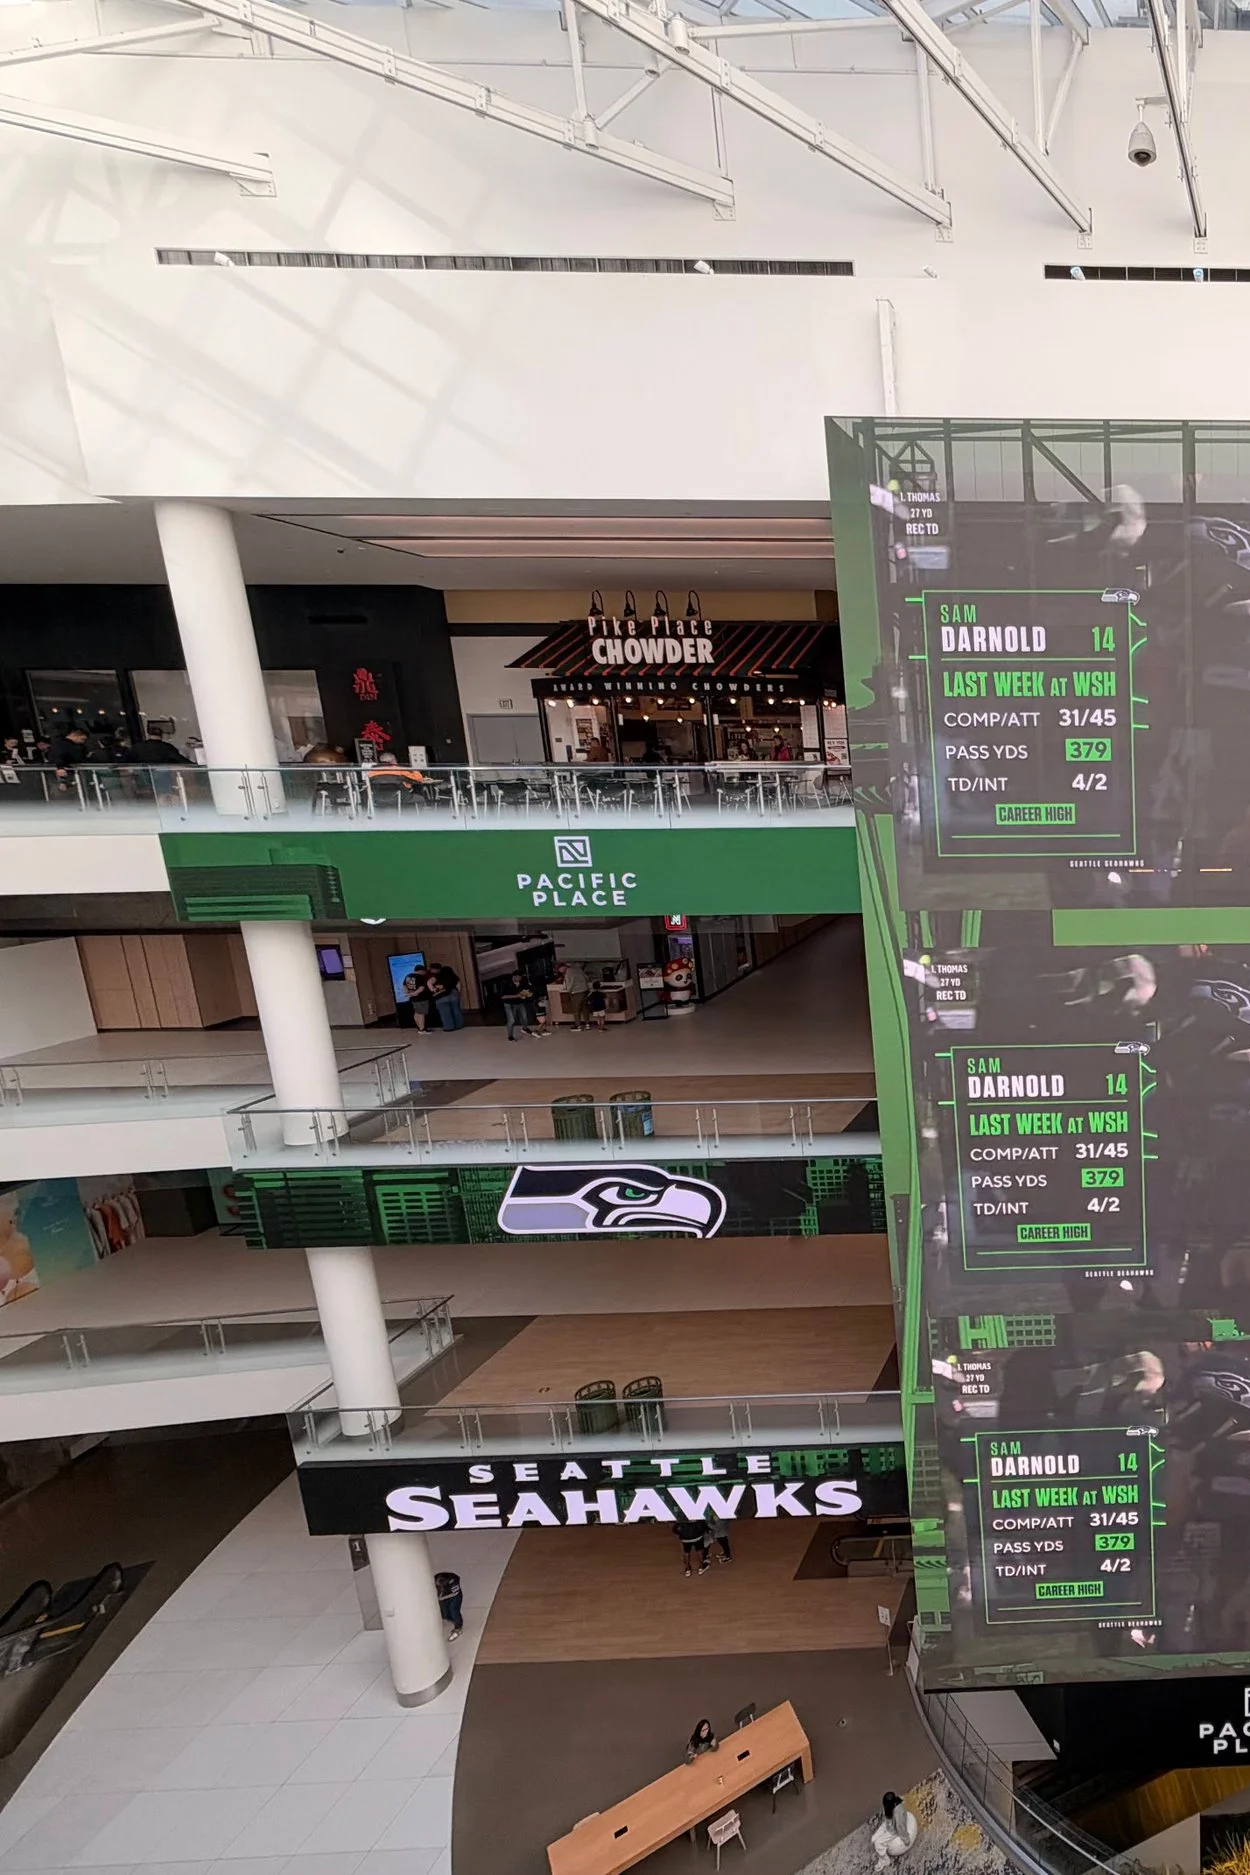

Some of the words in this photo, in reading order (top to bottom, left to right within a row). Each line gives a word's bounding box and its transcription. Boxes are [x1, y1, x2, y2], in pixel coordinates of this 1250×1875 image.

[907, 492, 940, 502] THOMAS
[910, 508, 920, 518] 27
[922, 508, 932, 518] YD
[906, 523, 925, 535] REC
[926, 523, 939, 534] TD
[940, 604, 977, 624] SAM
[588, 616, 636, 636] Pike
[651, 616, 712, 636] Place
[941, 626, 1046, 653] DARNOLD
[1091, 626, 1116, 652] 14
[592, 638, 715, 664] CHOWDER
[553, 682, 593, 692] AWARD
[604, 682, 677, 691] WINNING
[692, 682, 784, 693] CHOWDERS
[943, 672, 988, 698] LAST
[994, 671, 1045, 698] WEEK
[1050, 677, 1068, 696] AT
[1072, 671, 1117, 698] WSH
[944, 712, 1040, 728] COMP/ATT
[1058, 709, 1117, 728] 31/45
[945, 745, 990, 760] PASS
[993, 744, 1029, 760] YDS
[1070, 742, 1107, 760] 379
[948, 776, 1009, 792] TD/INT
[1072, 774, 1108, 792] 4/2
[999, 806, 1043, 823] CAREER
[1045, 805, 1074, 823] HIGH
[1070, 860, 1101, 868] SEATTLE
[518, 872, 638, 889] PACIFIC
[534, 890, 626, 907] PLACE
[938, 964, 968, 974] THOMAS
[940, 978, 949, 987] 27
[951, 978, 961, 987] YD
[936, 990, 953, 1001] REC
[954, 990, 966, 1000] TD
[968, 1058, 1001, 1074] SAM
[968, 1075, 1065, 1098] DARNOLD
[1106, 1073, 1128, 1095] 14
[970, 1113, 1011, 1136] LAST
[1016, 1113, 1062, 1135] WEEK
[1067, 1116, 1084, 1134] AT
[1088, 1111, 1128, 1133] WSH
[970, 1146, 1058, 1162] COMP/ATT
[1075, 1143, 1128, 1159] 31/45
[972, 1175, 1012, 1188] PASS
[1015, 1174, 1047, 1188] YDS
[1086, 1170, 1119, 1185] 379
[974, 1201, 1029, 1216] TD/INT
[1087, 1197, 1120, 1213] 4/2
[1020, 1225, 1060, 1241] CAREER
[1062, 1225, 1088, 1240] HIGH
[1085, 1270, 1114, 1278] SEATTLE
[963, 1362, 992, 1371] THOMAS
[965, 1374, 975, 1382] 27
[976, 1374, 985, 1382] YD
[962, 1384, 978, 1394] REC
[979, 1384, 990, 1394] TD
[990, 1442, 1021, 1455] SAM
[468, 1455, 773, 1484] SEATTLE
[991, 1455, 1080, 1477] DARNOLD
[1118, 1452, 1138, 1472] 14
[384, 1479, 863, 1532] SEAHAWKS
[993, 1489, 1030, 1509] LAST
[1035, 1487, 1078, 1507] WEEK
[1082, 1490, 1098, 1505] AT
[1101, 1485, 1139, 1505] WSH
[993, 1516, 1074, 1531] COMP/ATT
[1089, 1512, 1139, 1527] 31/45
[994, 1541, 1030, 1554] PASS
[1034, 1540, 1064, 1552] YDS
[1099, 1535, 1130, 1549] 379
[996, 1564, 1047, 1578] TD/INT
[1100, 1559, 1131, 1573] 4/2
[1038, 1583, 1076, 1597] CAREER
[1077, 1582, 1101, 1596] HIGH
